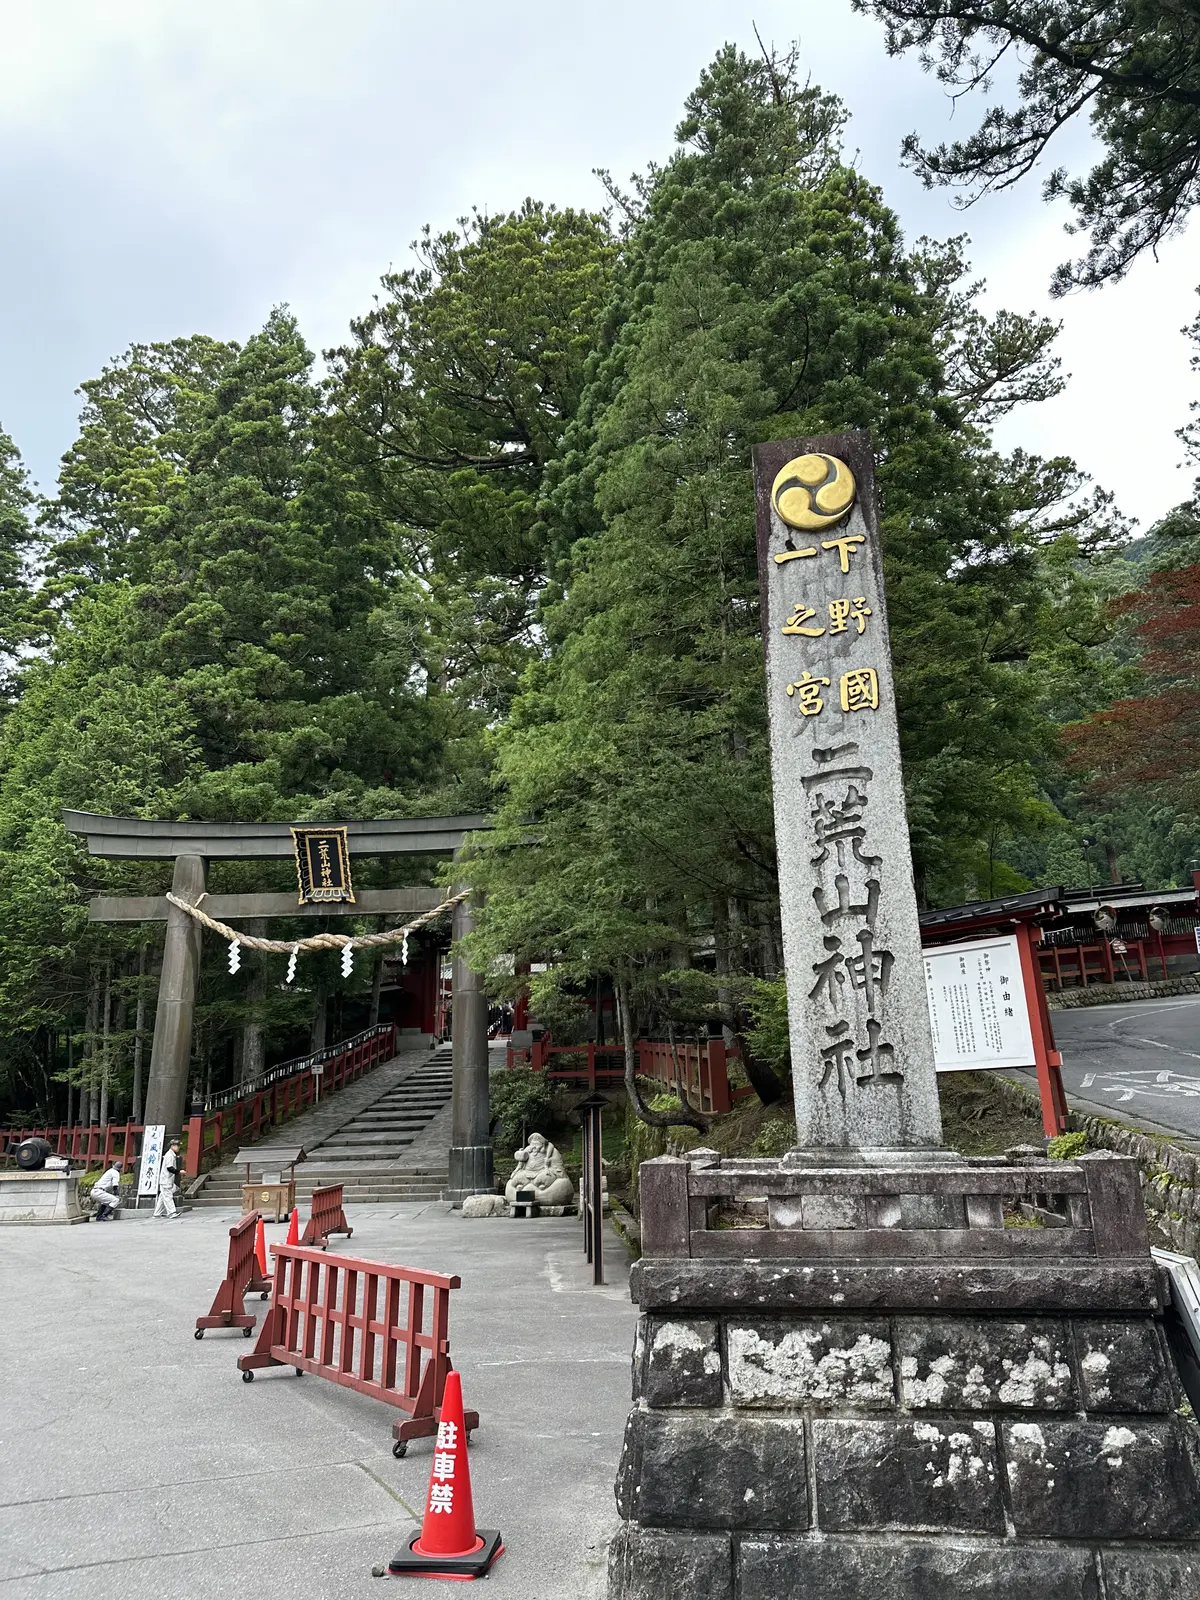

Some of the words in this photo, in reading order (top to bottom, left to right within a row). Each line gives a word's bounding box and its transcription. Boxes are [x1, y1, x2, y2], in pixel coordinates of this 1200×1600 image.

[773, 547, 831, 716] 一之宮
[821, 534, 880, 712] 下野國
[317, 840, 334, 888] 二荒山神社
[801, 741, 905, 1100] 二荒山神社
[999, 975, 1014, 1017] 御由緒
[429, 1421, 459, 1514] 駐車禁
